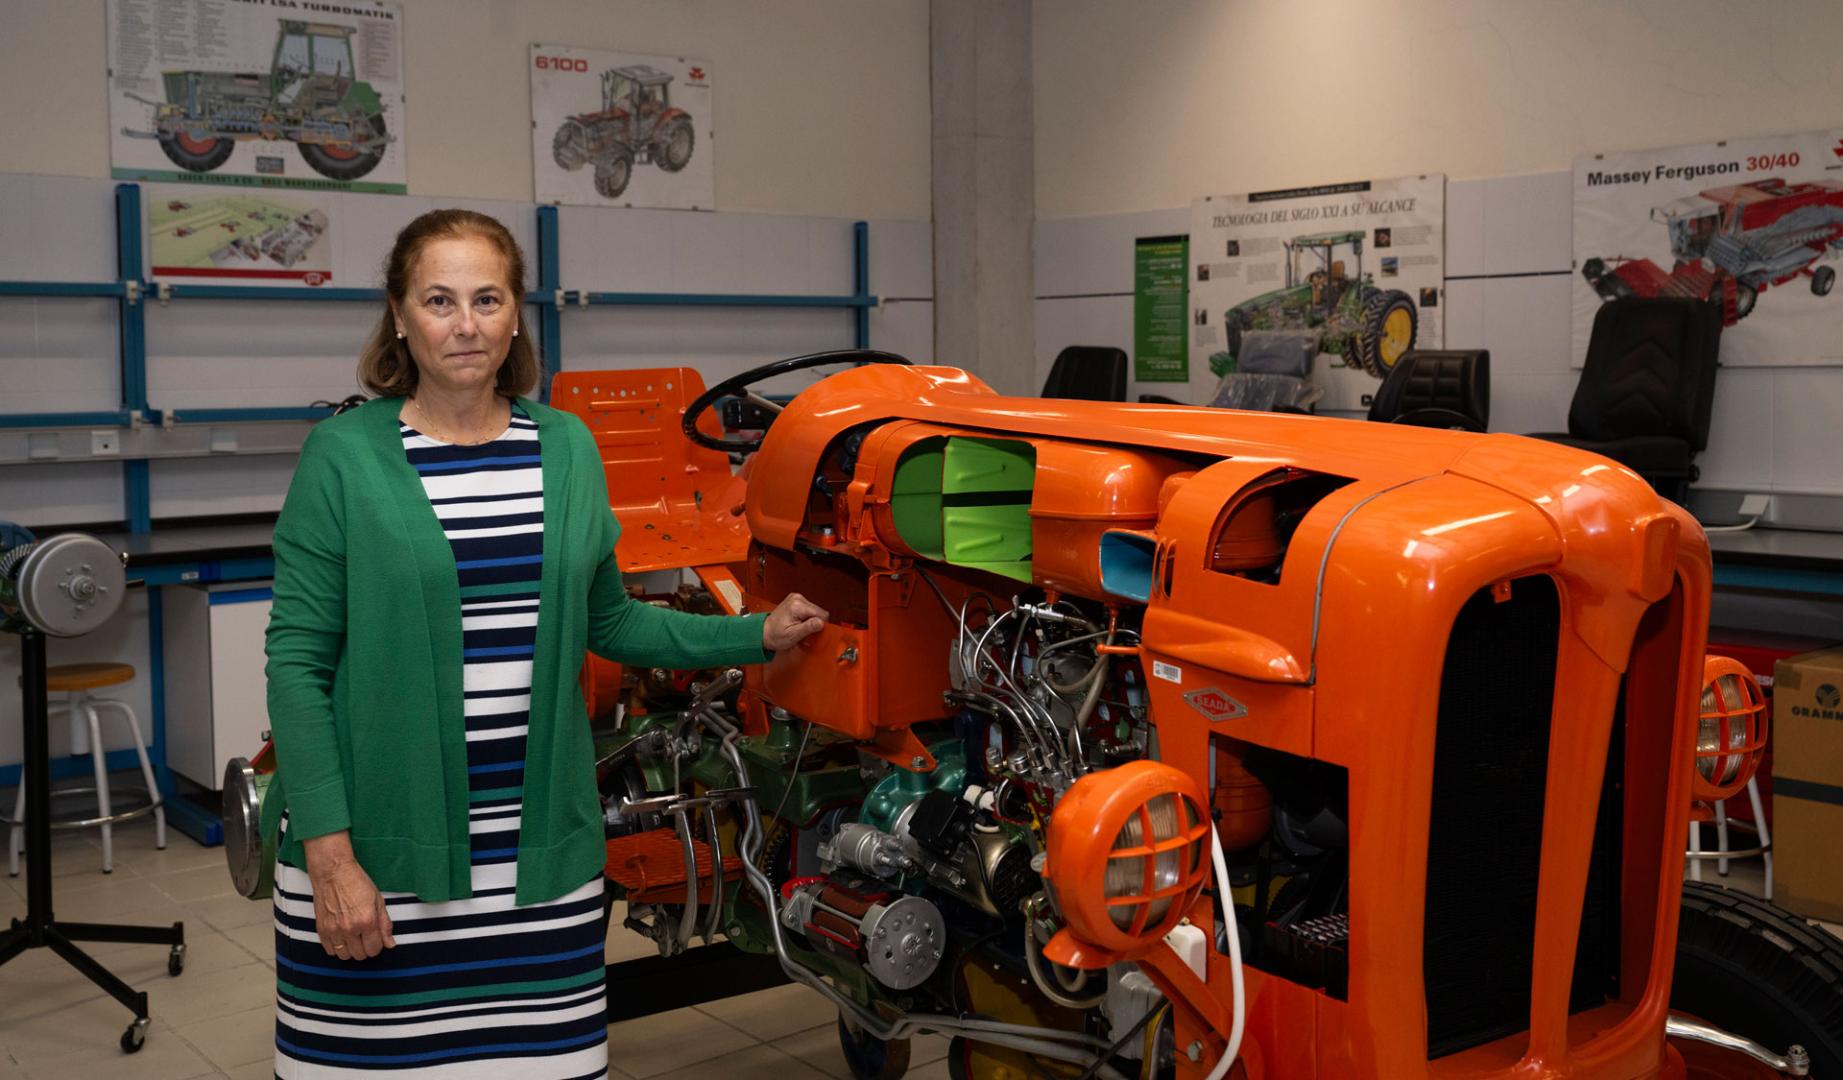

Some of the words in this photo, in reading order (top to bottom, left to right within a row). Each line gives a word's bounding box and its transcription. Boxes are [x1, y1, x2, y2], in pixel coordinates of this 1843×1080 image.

[302, 2, 394, 20] TURBOMATIK
[535, 55, 588, 73] 6100
[1587, 169, 1651, 187] Massey
[1655, 159, 1740, 181] Ferguson
[1746, 152, 1800, 172] 30/40
[1270, 208, 1288, 224] DEL
[1291, 206, 1319, 221] SIGLO
[1322, 204, 1340, 219] XXI
[1340, 205, 1348, 217] A
[1366, 198, 1417, 215] ALCANCE
